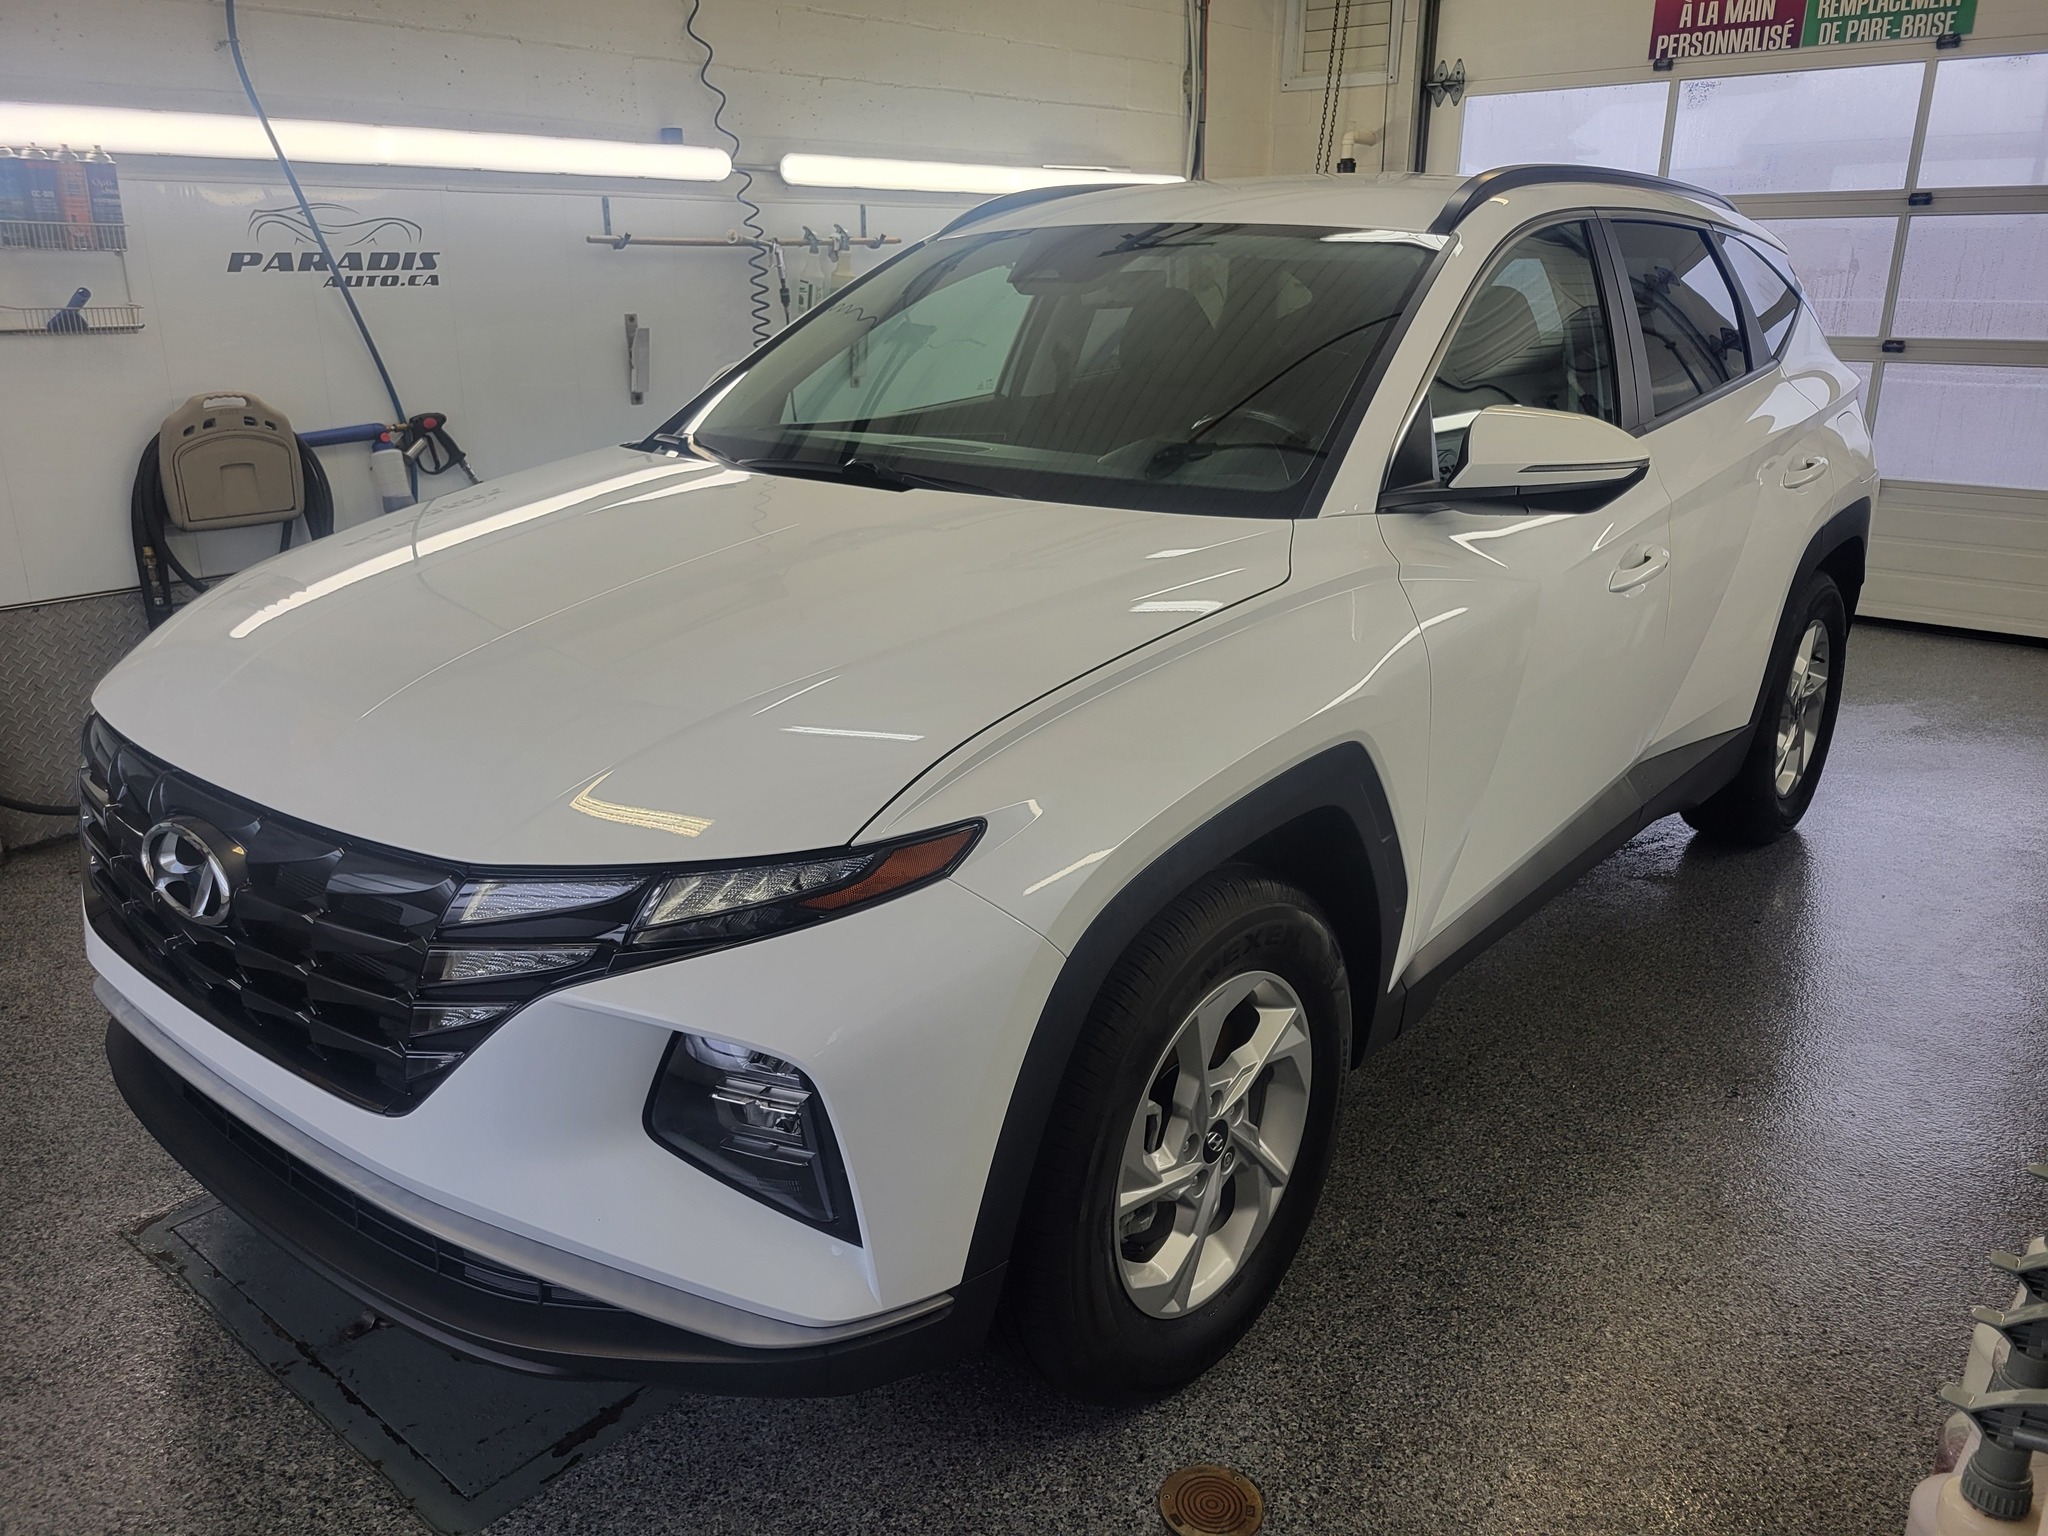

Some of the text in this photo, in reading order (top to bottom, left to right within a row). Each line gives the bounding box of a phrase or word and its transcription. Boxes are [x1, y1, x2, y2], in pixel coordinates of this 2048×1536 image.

[1679, 0, 1776, 28] À LA MAIN
[1817, 0, 1961, 19] REMPLAC
[1655, 18, 1795, 59] PERSONNALISÉ
[1818, 11, 1957, 46] DE PARE-BRISE
[227, 252, 441, 272] PARADIS
[323, 274, 440, 288] AUTO.CA
